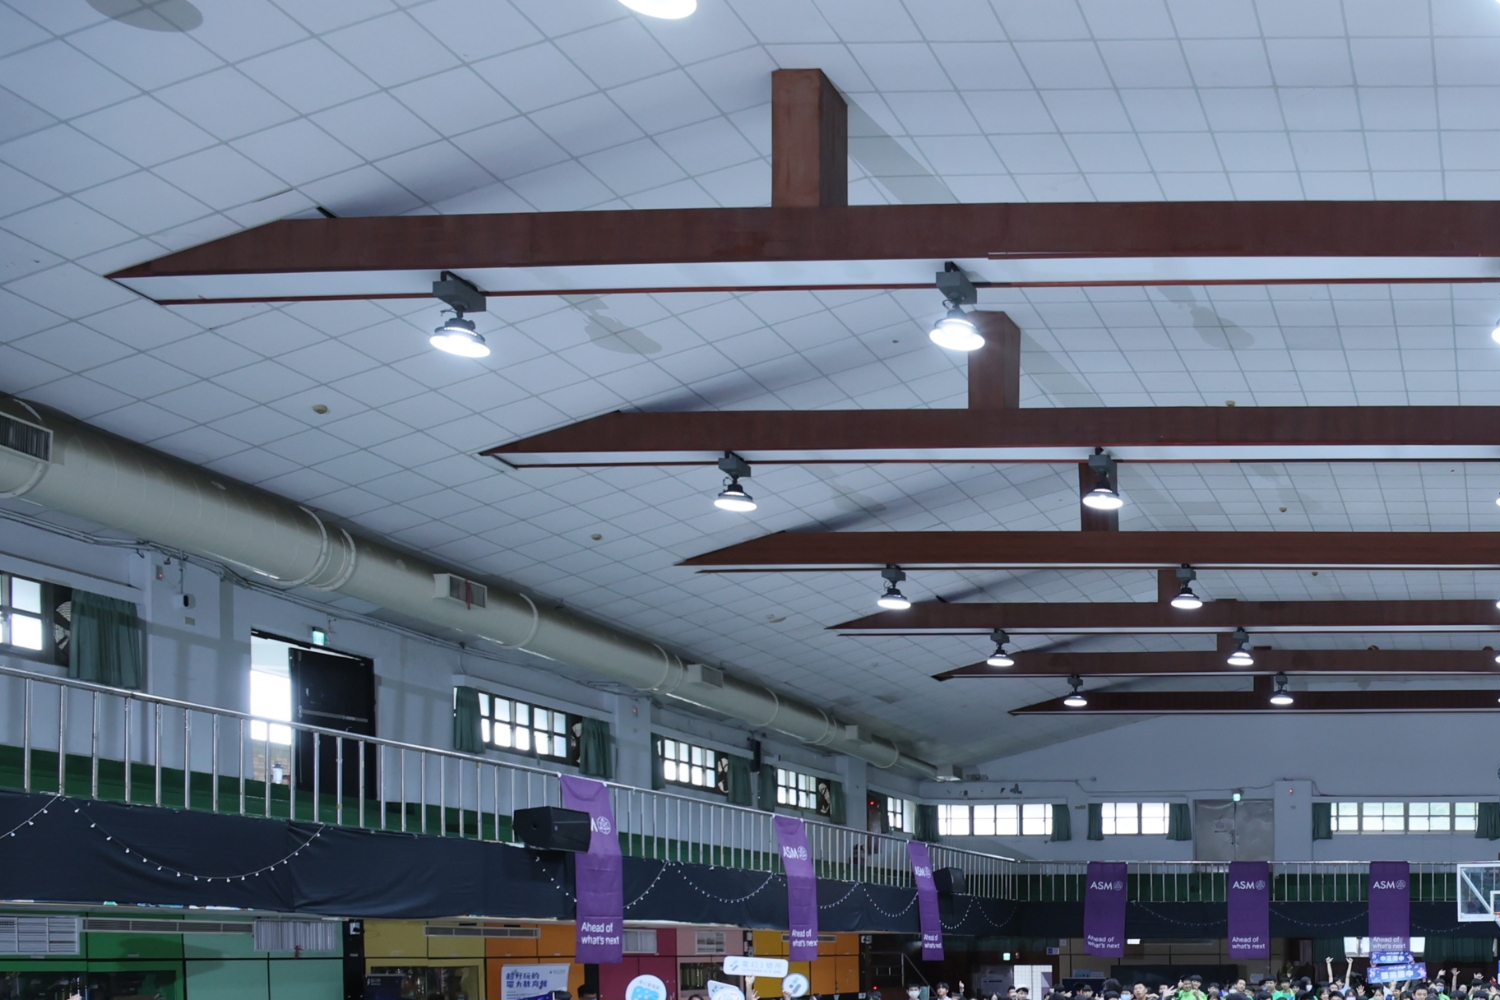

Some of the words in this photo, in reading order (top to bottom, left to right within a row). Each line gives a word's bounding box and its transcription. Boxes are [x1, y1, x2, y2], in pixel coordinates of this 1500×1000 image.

[1090, 881, 1113, 891] ASM
[1232, 881, 1255, 890] ASM
[1373, 880, 1395, 890] ASM
[581, 922, 604, 933] Ahead
[605, 921, 614, 932] of
[581, 934, 604, 945] what's
[604, 936, 620, 945] next
[1087, 935, 1105, 943] Ahead
